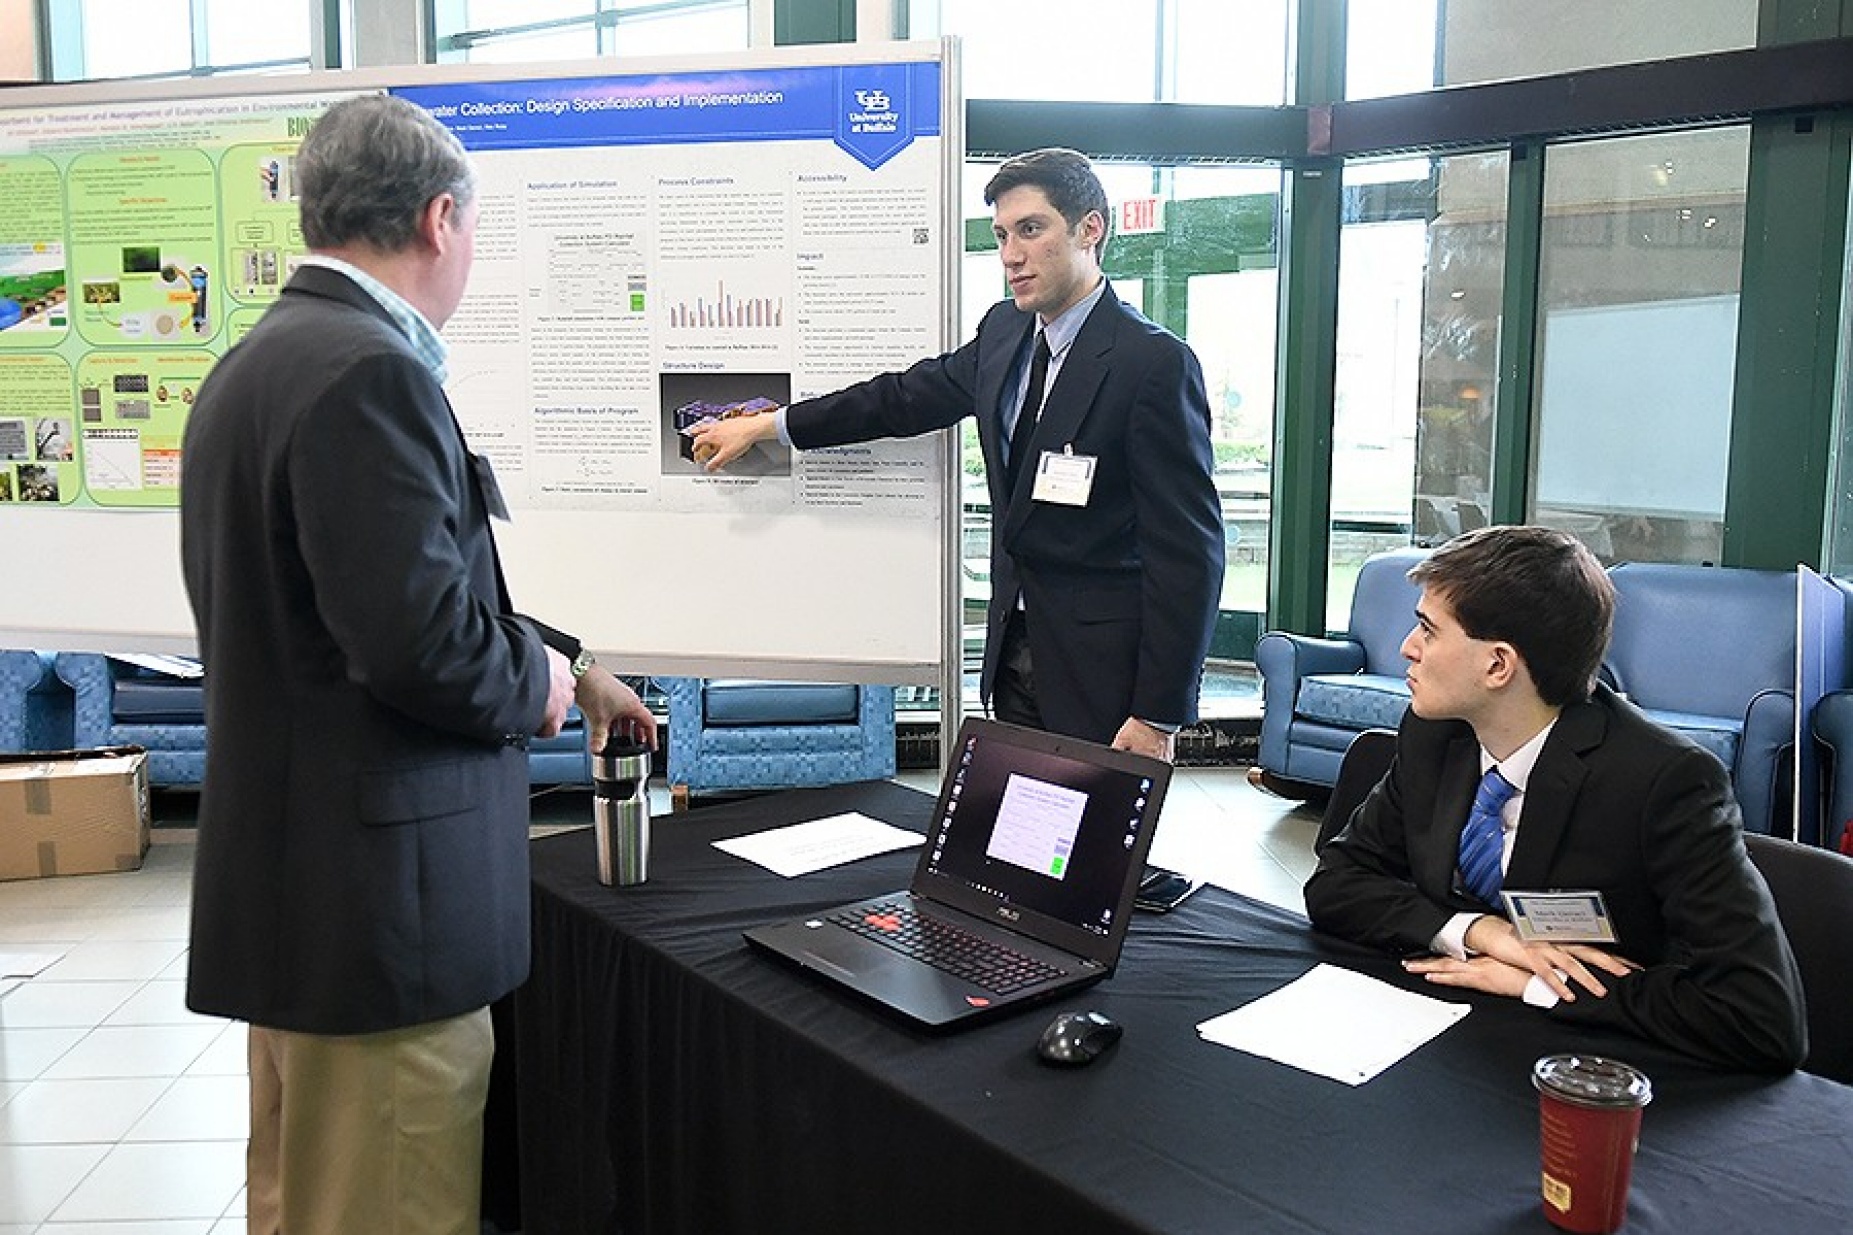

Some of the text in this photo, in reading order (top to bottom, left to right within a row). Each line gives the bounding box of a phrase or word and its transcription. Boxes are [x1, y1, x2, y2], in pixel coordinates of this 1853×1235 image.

[461, 101, 524, 116] Collection:
[526, 98, 569, 114] Design
[572, 96, 653, 112] Specification
[656, 94, 680, 109] and
[683, 90, 784, 109] Implementation
[47, 112, 90, 123] Treatment
[92, 111, 108, 121] and
[110, 109, 161, 121] Management
[176, 104, 240, 117] Eutrophication
[253, 100, 318, 113] Environmental
[848, 111, 899, 124] University
[659, 176, 734, 186] Process Constraints
[797, 174, 847, 182] Accessibility
[527, 179, 618, 191] Application of Simulation
[1124, 199, 1157, 231] EXIT
[797, 253, 824, 261] Impact
[663, 361, 725, 370] Structure Design
[534, 406, 639, 417] Algorithmic Basis of Program
